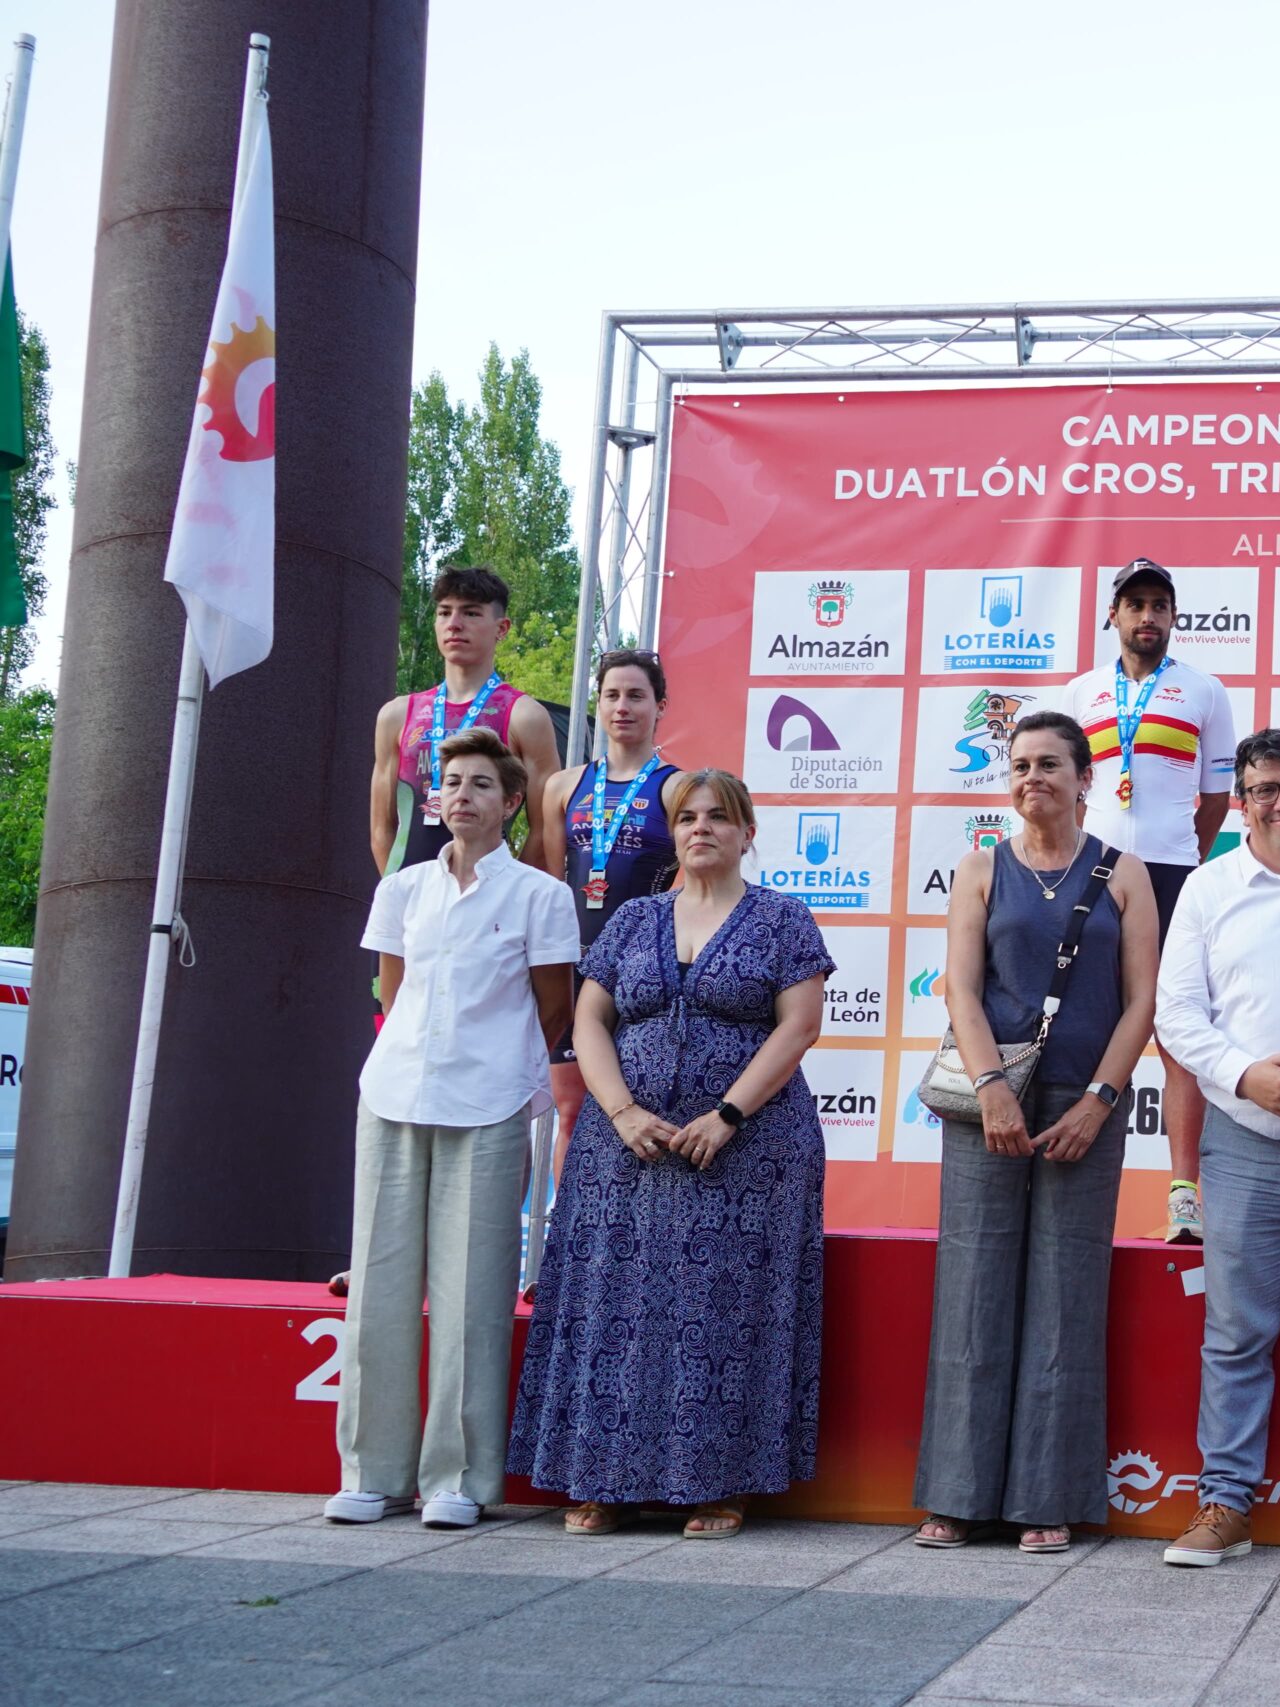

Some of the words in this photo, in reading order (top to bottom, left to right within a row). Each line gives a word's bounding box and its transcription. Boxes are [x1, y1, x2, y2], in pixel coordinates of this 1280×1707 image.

[834, 457, 1047, 500] DUATLÓN
[1061, 462, 1197, 500] CROS,
[768, 633, 889, 659] Almazán
[945, 629, 1056, 651] LOTERÍAS
[1175, 635, 1194, 644] Ven
[1195, 635, 1216, 644] Vive
[1217, 636, 1251, 645] Vuelve
[787, 662, 875, 672] AYUNTAMIENTO
[955, 658, 978, 667] CON
[980, 658, 992, 667] EL
[994, 657, 1043, 667] DEPORTE
[791, 756, 884, 773] Diputación
[789, 773, 811, 790] de
[814, 773, 858, 790] Soria
[760, 866, 871, 888] LOTERÍAS
[811, 895, 858, 905] DEPORTE
[855, 987, 881, 1003] de
[830, 1006, 880, 1023] León
[820, 1117, 842, 1126] Vive
[842, 1118, 876, 1127] Vuelve
[295, 1317, 347, 1403] 2
